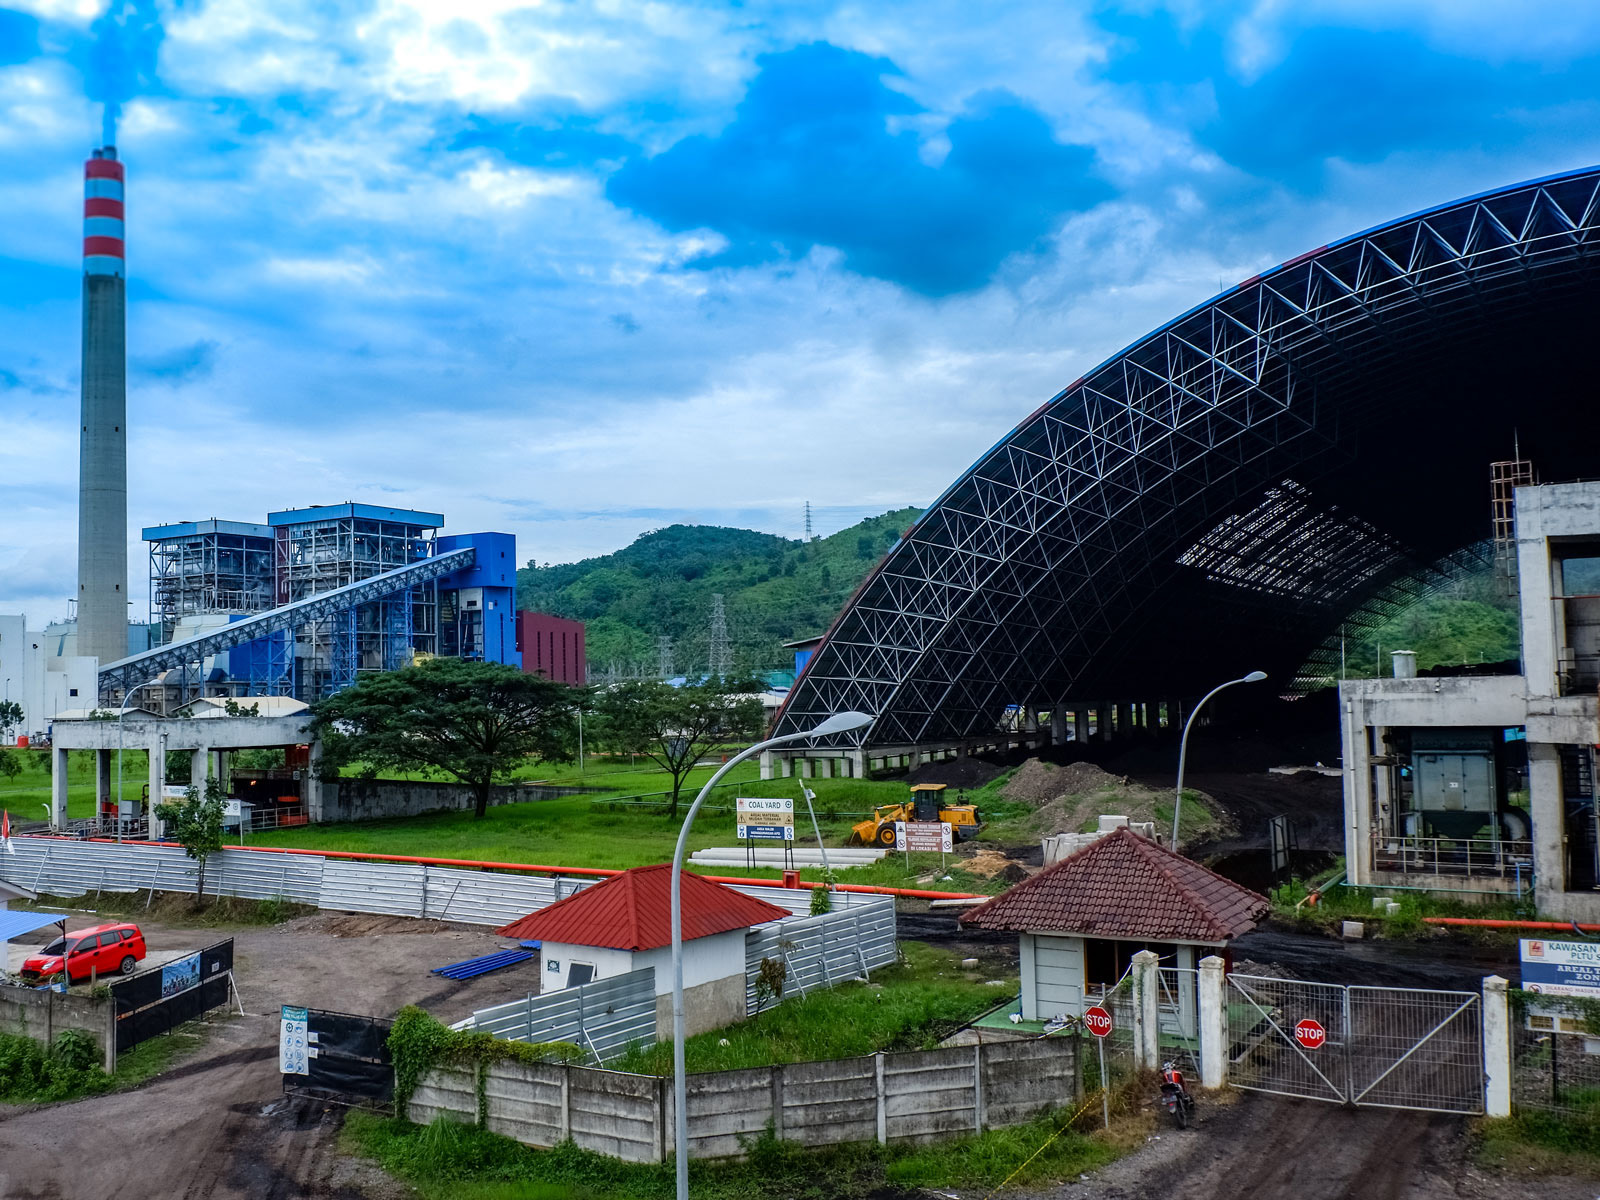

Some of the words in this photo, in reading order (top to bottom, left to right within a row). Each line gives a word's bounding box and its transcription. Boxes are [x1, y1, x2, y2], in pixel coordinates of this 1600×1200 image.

[1549, 943, 1597, 952] KAWASAN
[1557, 965, 1593, 974] AREAL
[1087, 1014, 1110, 1028] STOP
[1297, 1027, 1322, 1040] STOP
